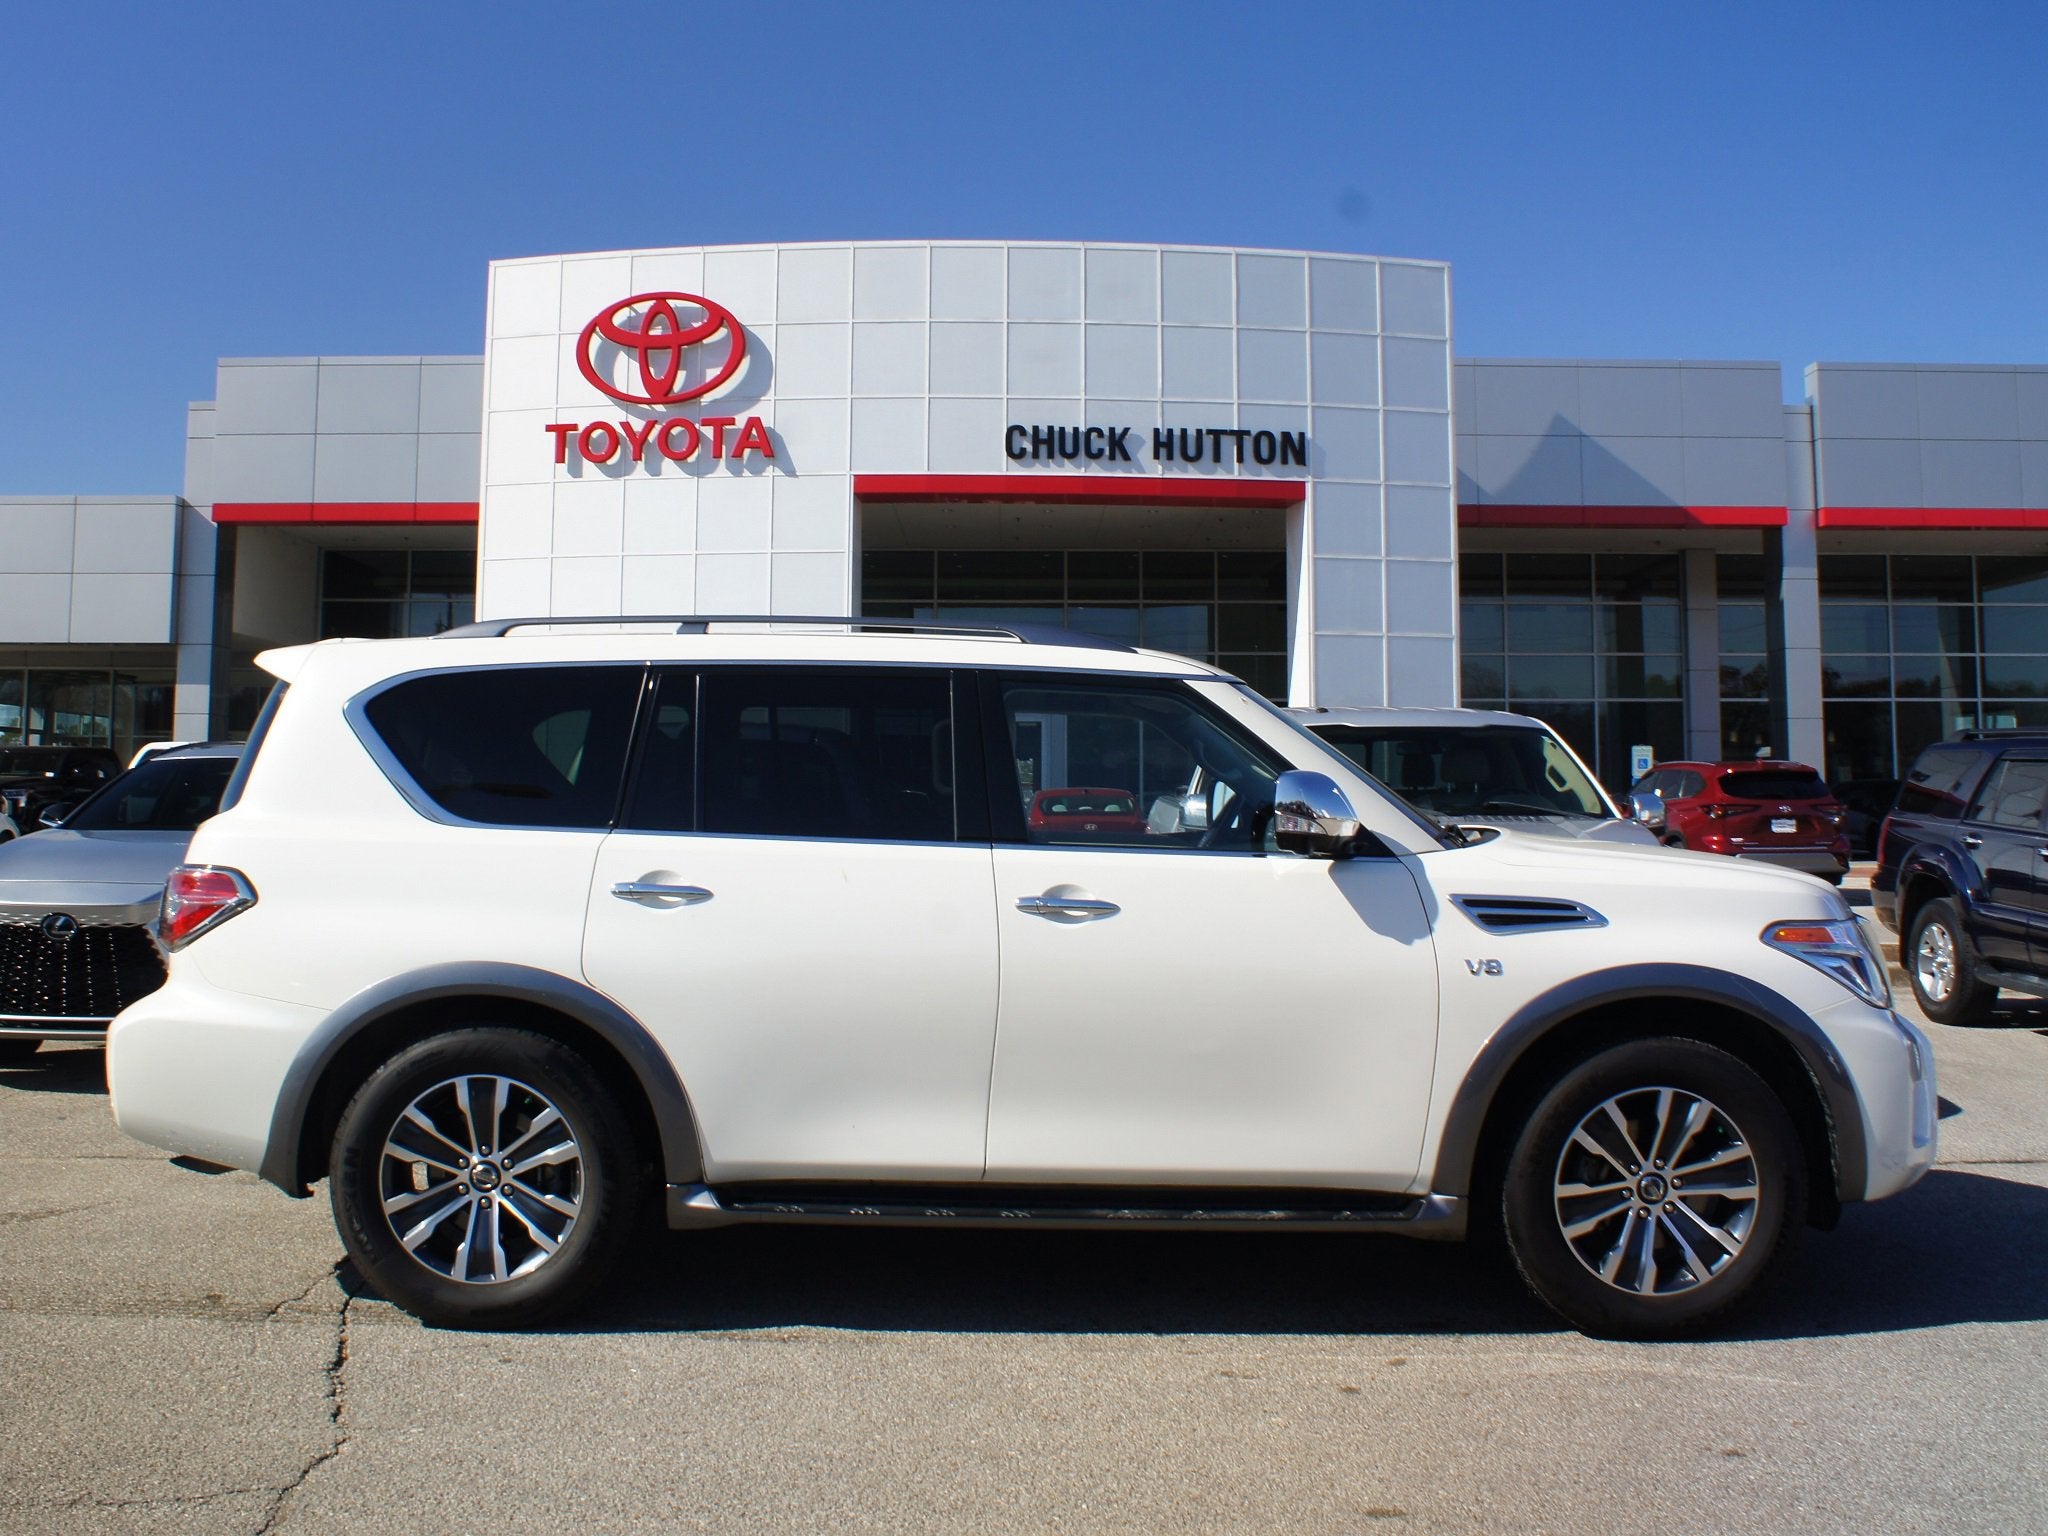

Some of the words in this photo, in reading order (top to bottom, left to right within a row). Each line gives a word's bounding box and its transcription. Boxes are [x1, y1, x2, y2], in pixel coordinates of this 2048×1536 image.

[545, 416, 775, 464] TOYOTA
[1005, 424, 1132, 462] CHUCK
[1152, 427, 1307, 467] HUTTON
[1464, 958, 1503, 976] V8
